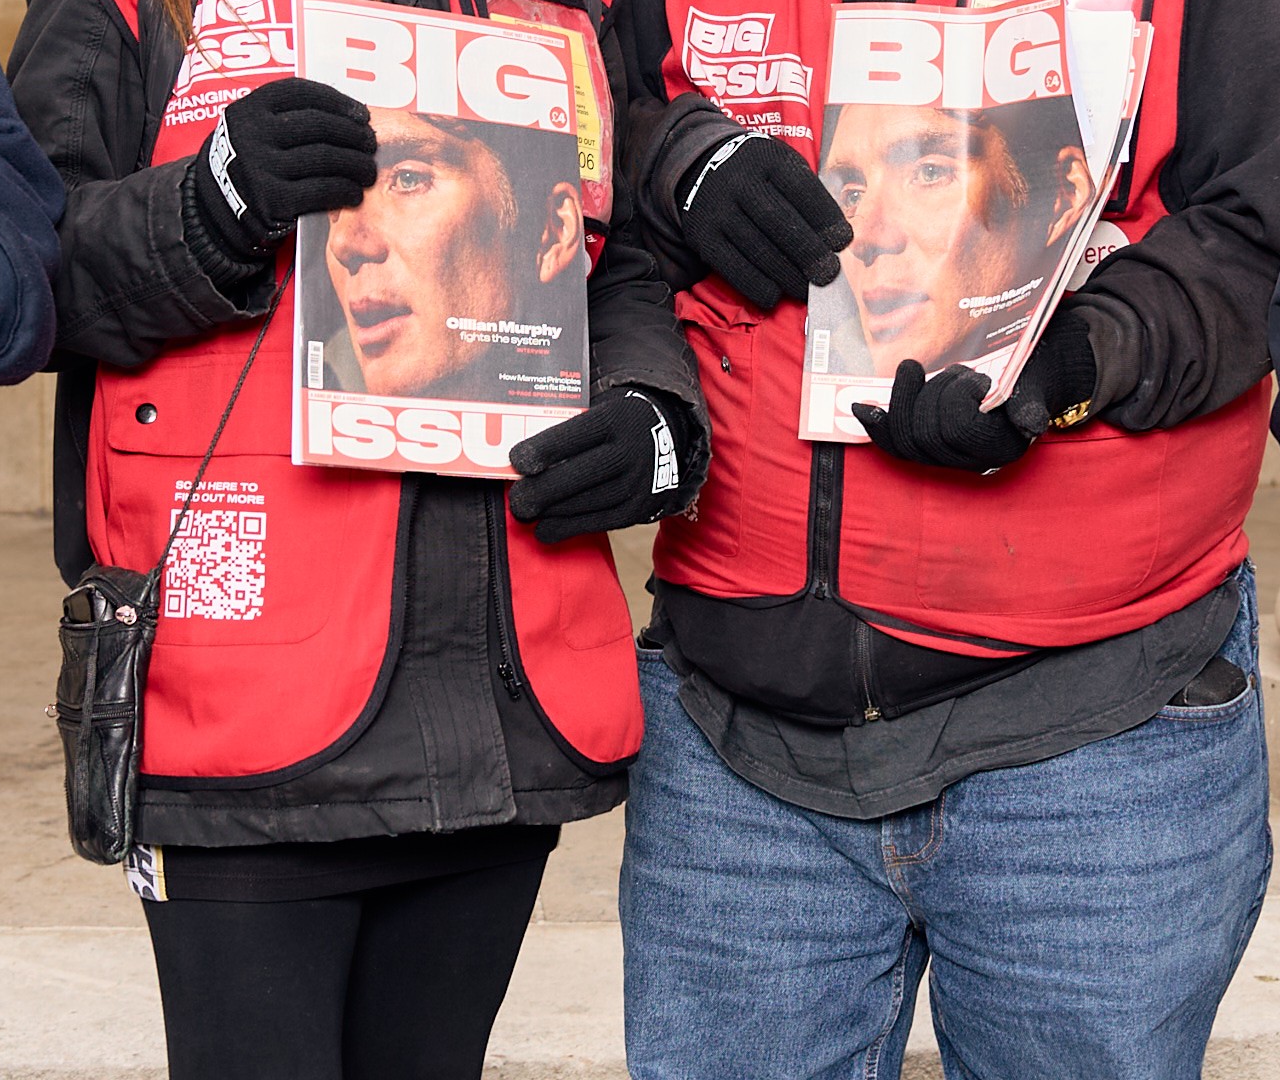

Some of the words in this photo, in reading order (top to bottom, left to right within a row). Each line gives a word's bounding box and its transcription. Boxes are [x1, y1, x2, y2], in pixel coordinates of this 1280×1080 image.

[690, 18, 765, 54] BIG
[177, 31, 295, 89] ISSU
[828, 11, 1065, 108] BIG
[304, 8, 571, 133] BIG
[690, 50, 808, 98] ISSUE
[1045, 75, 1061, 88] £4
[166, 87, 251, 113] CHANGING
[551, 111, 567, 125] £4
[746, 112, 782, 125] LIVES
[583, 138, 596, 147] OUT
[958, 295, 1000, 309] Cillian
[1001, 277, 1043, 301] Murphy
[970, 306, 992, 318] fights
[446, 317, 497, 332] Cillian
[499, 321, 562, 339] Murphy
[460, 331, 490, 343] fights
[492, 333, 509, 344] the
[511, 336, 550, 346] system
[516, 347, 550, 355] INTERVIEW
[499, 373, 517, 381] How
[517, 374, 546, 383] Marmot
[546, 376, 581, 386] Principles
[560, 370, 581, 378] PLUS
[558, 384, 581, 393] Britain
[308, 400, 566, 468] ISSU
[175, 480, 207, 491] SCN
[207, 482, 238, 491] HERE
[239, 482, 259, 492] TO
[201, 493, 225, 503] OUT
[227, 494, 265, 504] MORE
